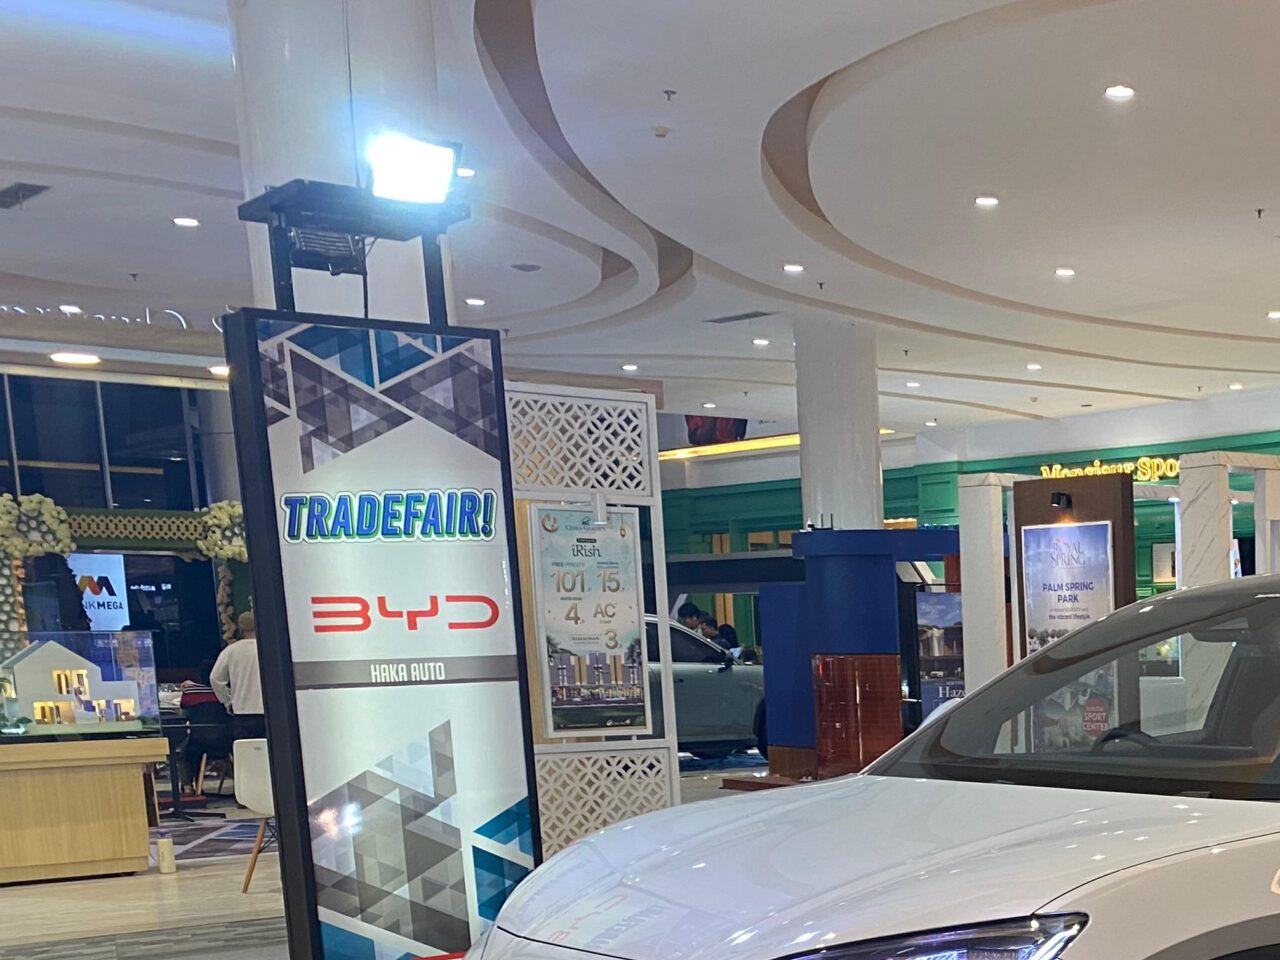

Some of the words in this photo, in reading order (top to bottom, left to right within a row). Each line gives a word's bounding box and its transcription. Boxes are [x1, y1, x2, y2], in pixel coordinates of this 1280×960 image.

[1137, 457, 1180, 481] Spo
[283, 491, 495, 541] TRADEFAIR!
[572, 544, 602, 557] iRish
[1051, 554, 1086, 568] SPRING
[551, 570, 584, 592] 101
[597, 570, 620, 592] 15
[1042, 583, 1063, 592] PALM
[1065, 582, 1094, 591] SPRING
[1057, 594, 1079, 603] PARK
[311, 595, 499, 632] BYD
[565, 602, 580, 625] 4
[594, 604, 616, 618] AC
[605, 630, 618, 649] 3
[371, 664, 407, 683] HAKA
[411, 662, 445, 681] AUTO
[1084, 713, 1107, 721] SPORT
